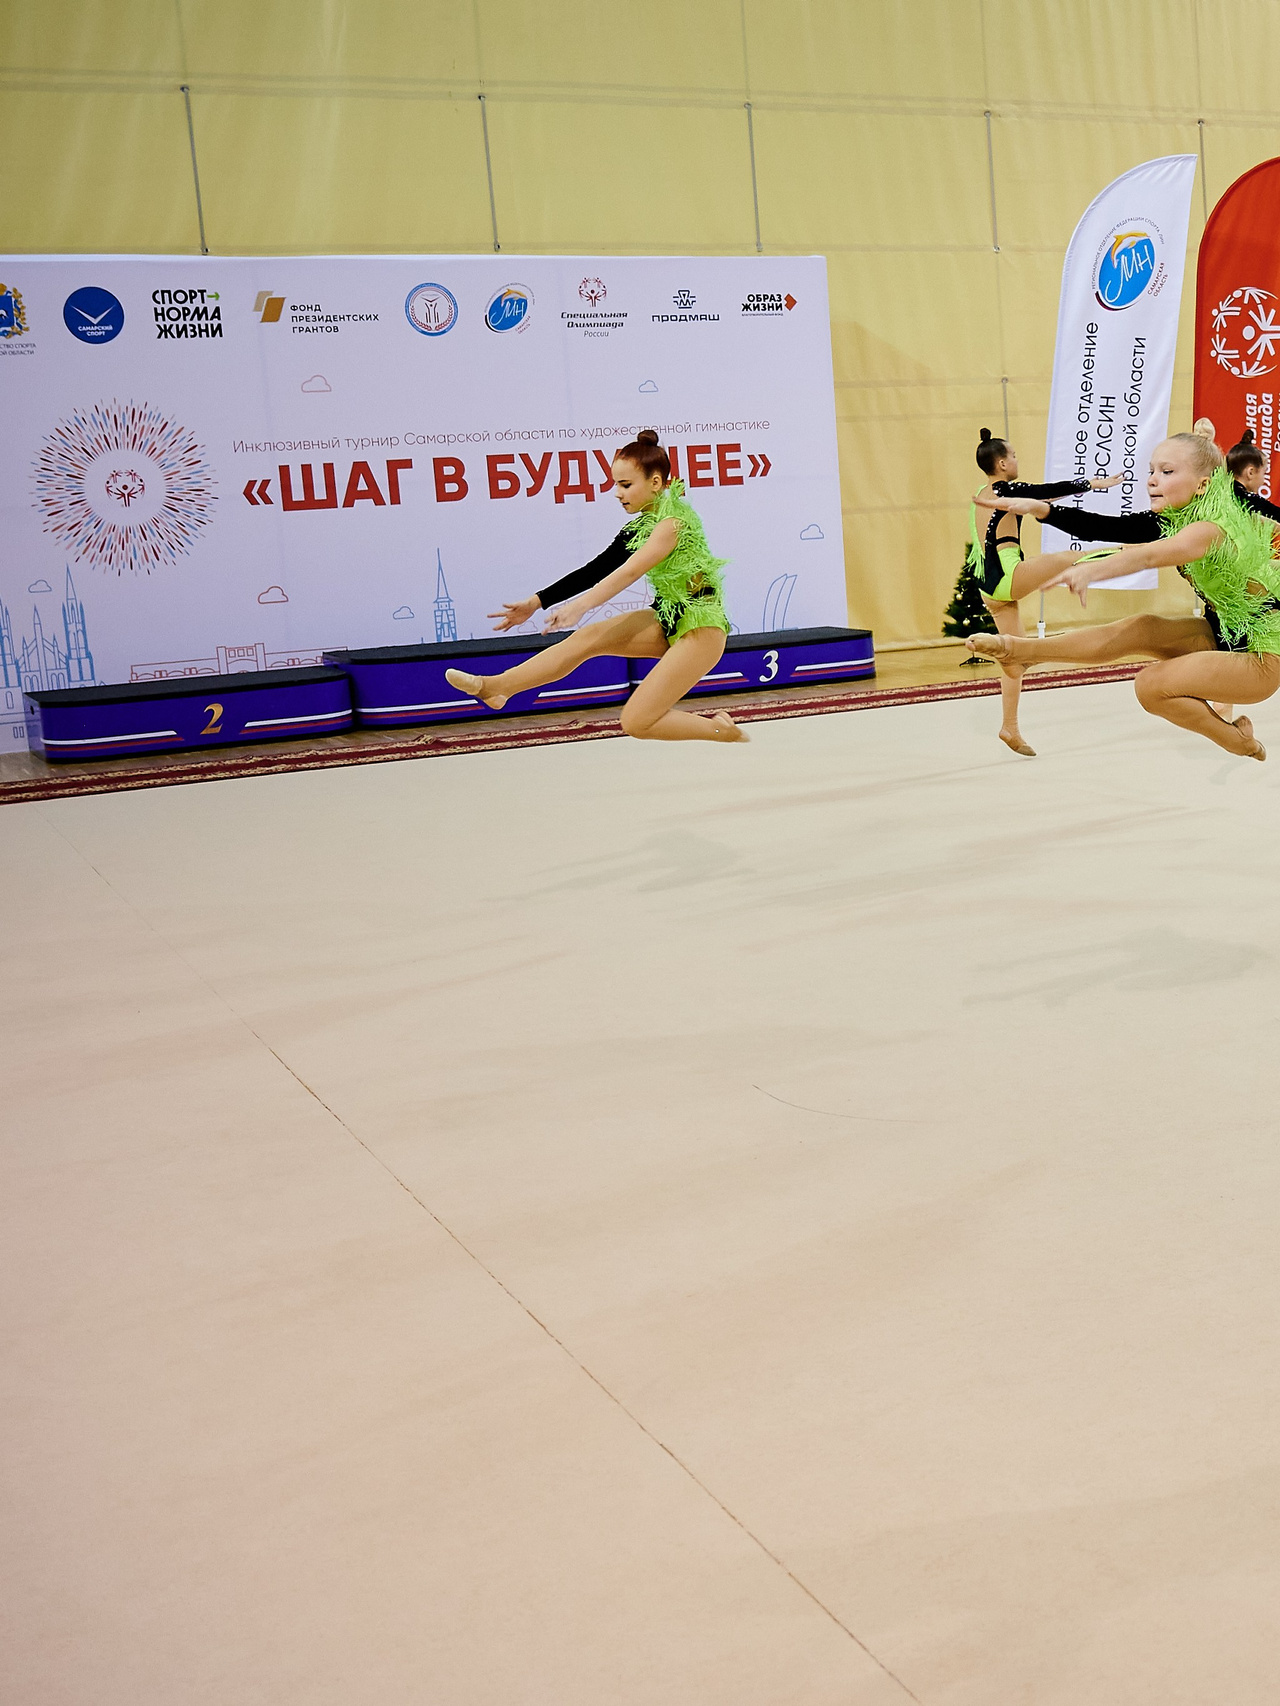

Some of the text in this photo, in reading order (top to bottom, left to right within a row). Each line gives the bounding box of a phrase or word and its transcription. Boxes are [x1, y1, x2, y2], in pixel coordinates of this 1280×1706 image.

[152, 289, 207, 305] СПОРТ
[747, 293, 782, 303] ОБРАЗ
[154, 306, 222, 322] НОРМА
[290, 304, 322, 312] ФОНД
[741, 303, 783, 312] ЖИЗНИ
[291, 314, 380, 323] ПРЕЗИДЕНТСКИХ
[560, 312, 628, 320] Специальная
[156, 324, 224, 340] ЖИЗНИ
[292, 325, 340, 334] ГРАНТОВ
[566, 321, 624, 330] Олимпиада
[1077, 322, 1099, 424] отделение
[1123, 337, 1147, 418] области
[232, 436, 341, 454] Инклюзивный
[344, 434, 400, 450] турнир
[403, 430, 491, 447] Самарской
[495, 427, 555, 442] области
[558, 427, 577, 439] по
[695, 419, 770, 433] гимнастике
[242, 458, 413, 512] «ШАГ
[432, 456, 469, 503] В
[759, 649, 779, 682] 3
[200, 702, 224, 735] 2
